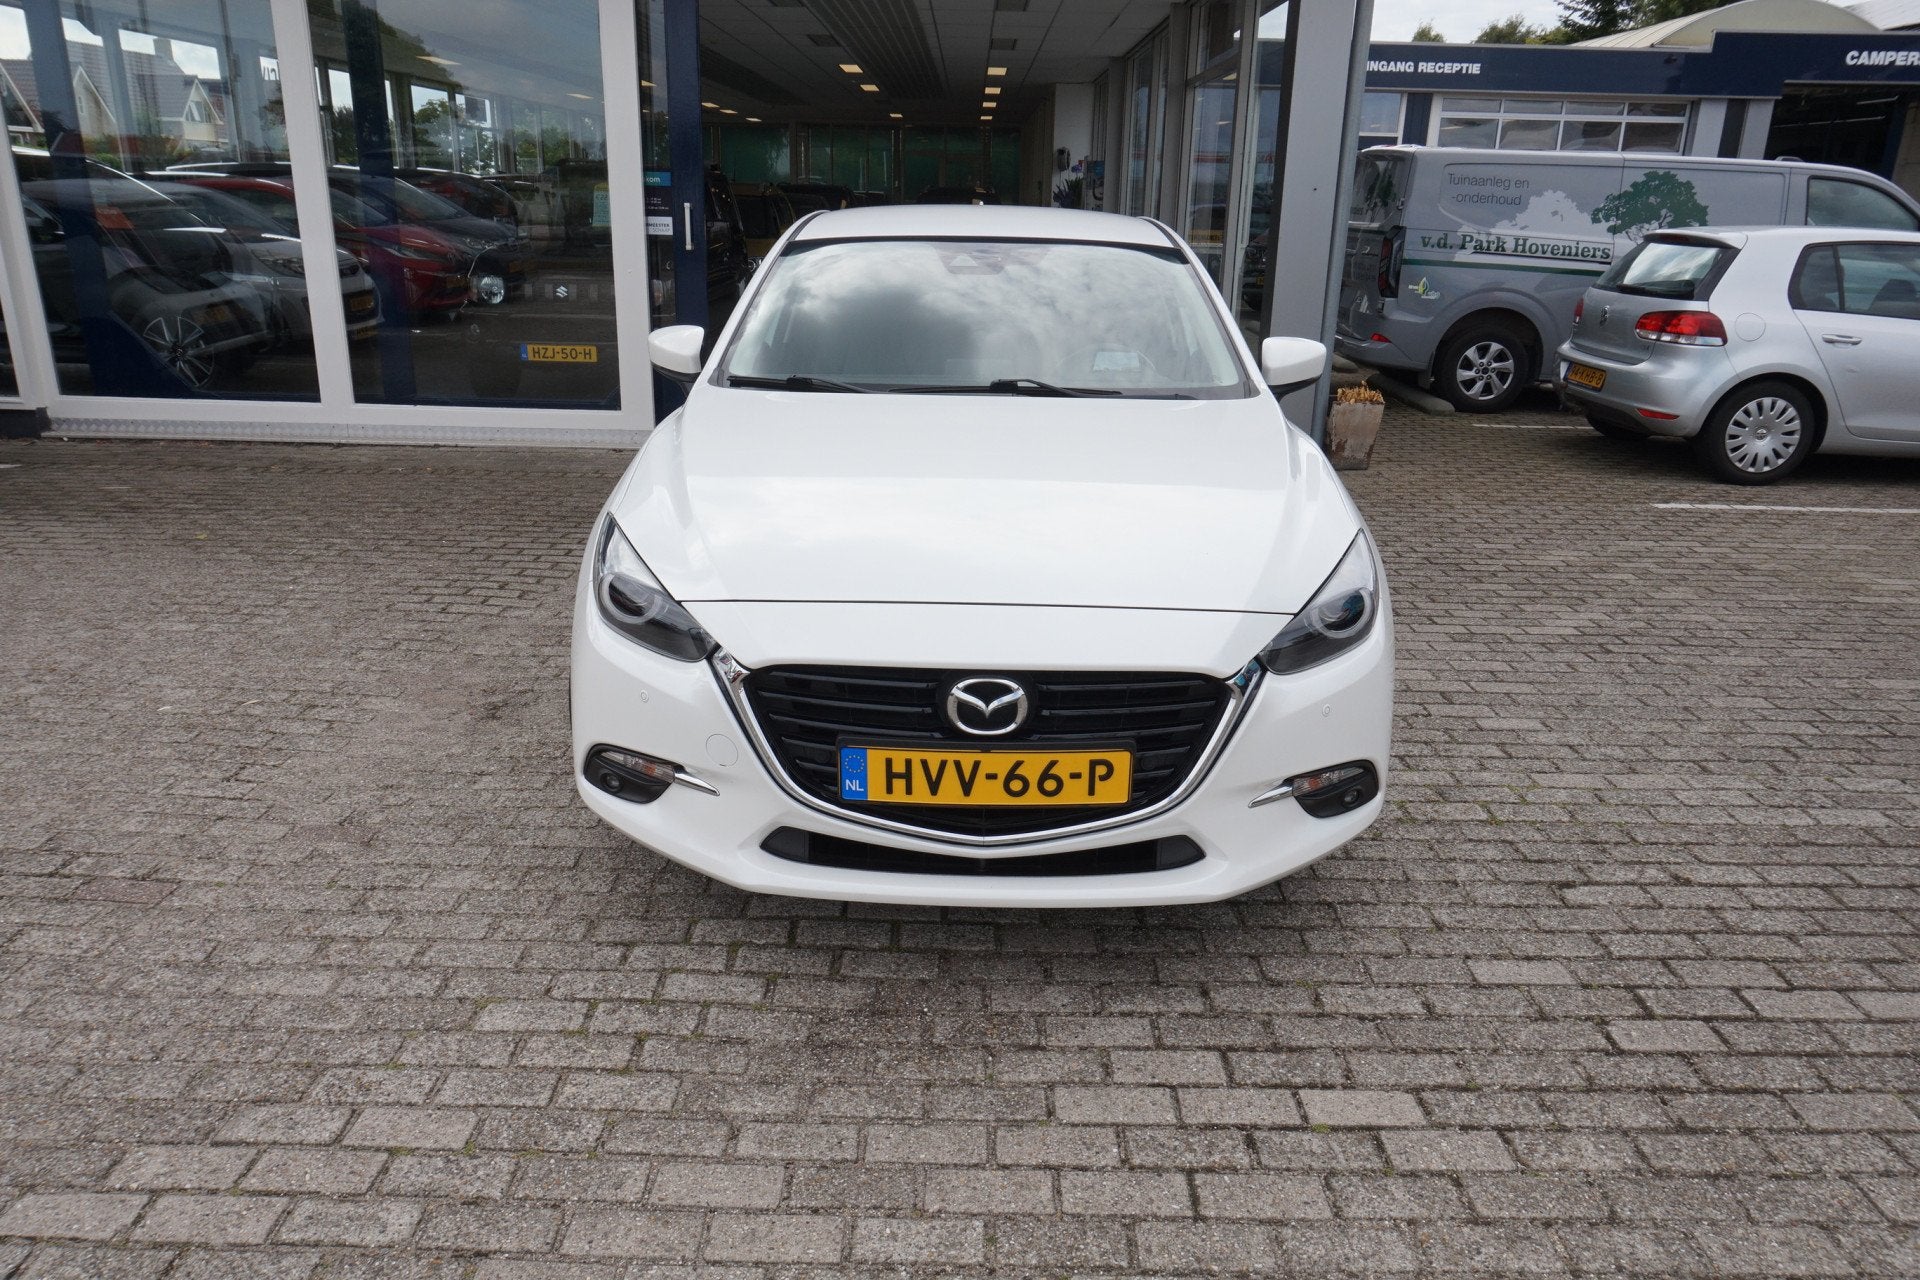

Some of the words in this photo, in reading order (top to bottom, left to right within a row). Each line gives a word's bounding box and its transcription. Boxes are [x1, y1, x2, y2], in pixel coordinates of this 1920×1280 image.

[1845, 50, 1920, 66] CAMPER
[1366, 60, 1415, 73] INGANG
[1417, 61, 1482, 75] RECEPTIE
[1448, 173, 1511, 190] Tuinaanleg
[1514, 178, 1530, 189] en
[1451, 192, 1522, 206] -onderhoud
[1420, 233, 1453, 250] v.d.
[1459, 234, 1508, 253] Park
[1511, 237, 1611, 260] Hoveniers
[532, 346, 592, 360] HZJ-50-H
[845, 779, 864, 792] NL
[885, 757, 1115, 798] HVV-66-P
